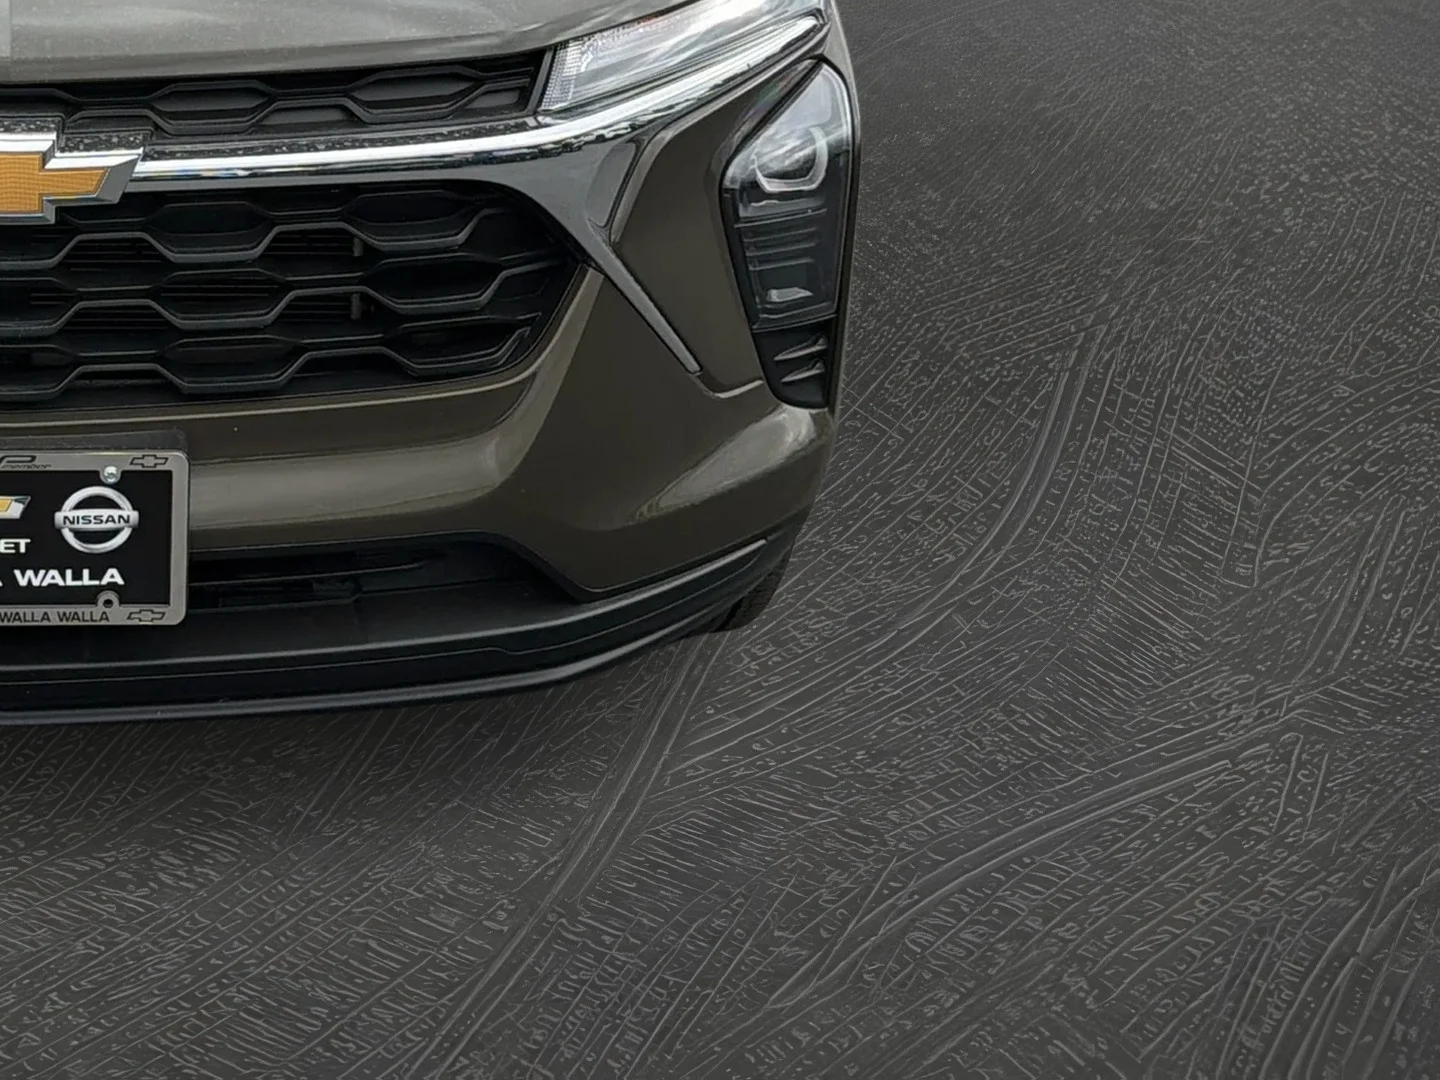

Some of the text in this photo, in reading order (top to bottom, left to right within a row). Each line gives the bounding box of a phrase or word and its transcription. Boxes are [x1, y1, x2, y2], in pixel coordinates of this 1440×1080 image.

[62, 514, 131, 526] NISSAN
[13, 568, 124, 586] WALLA
[55, 611, 110, 623] WALLA
